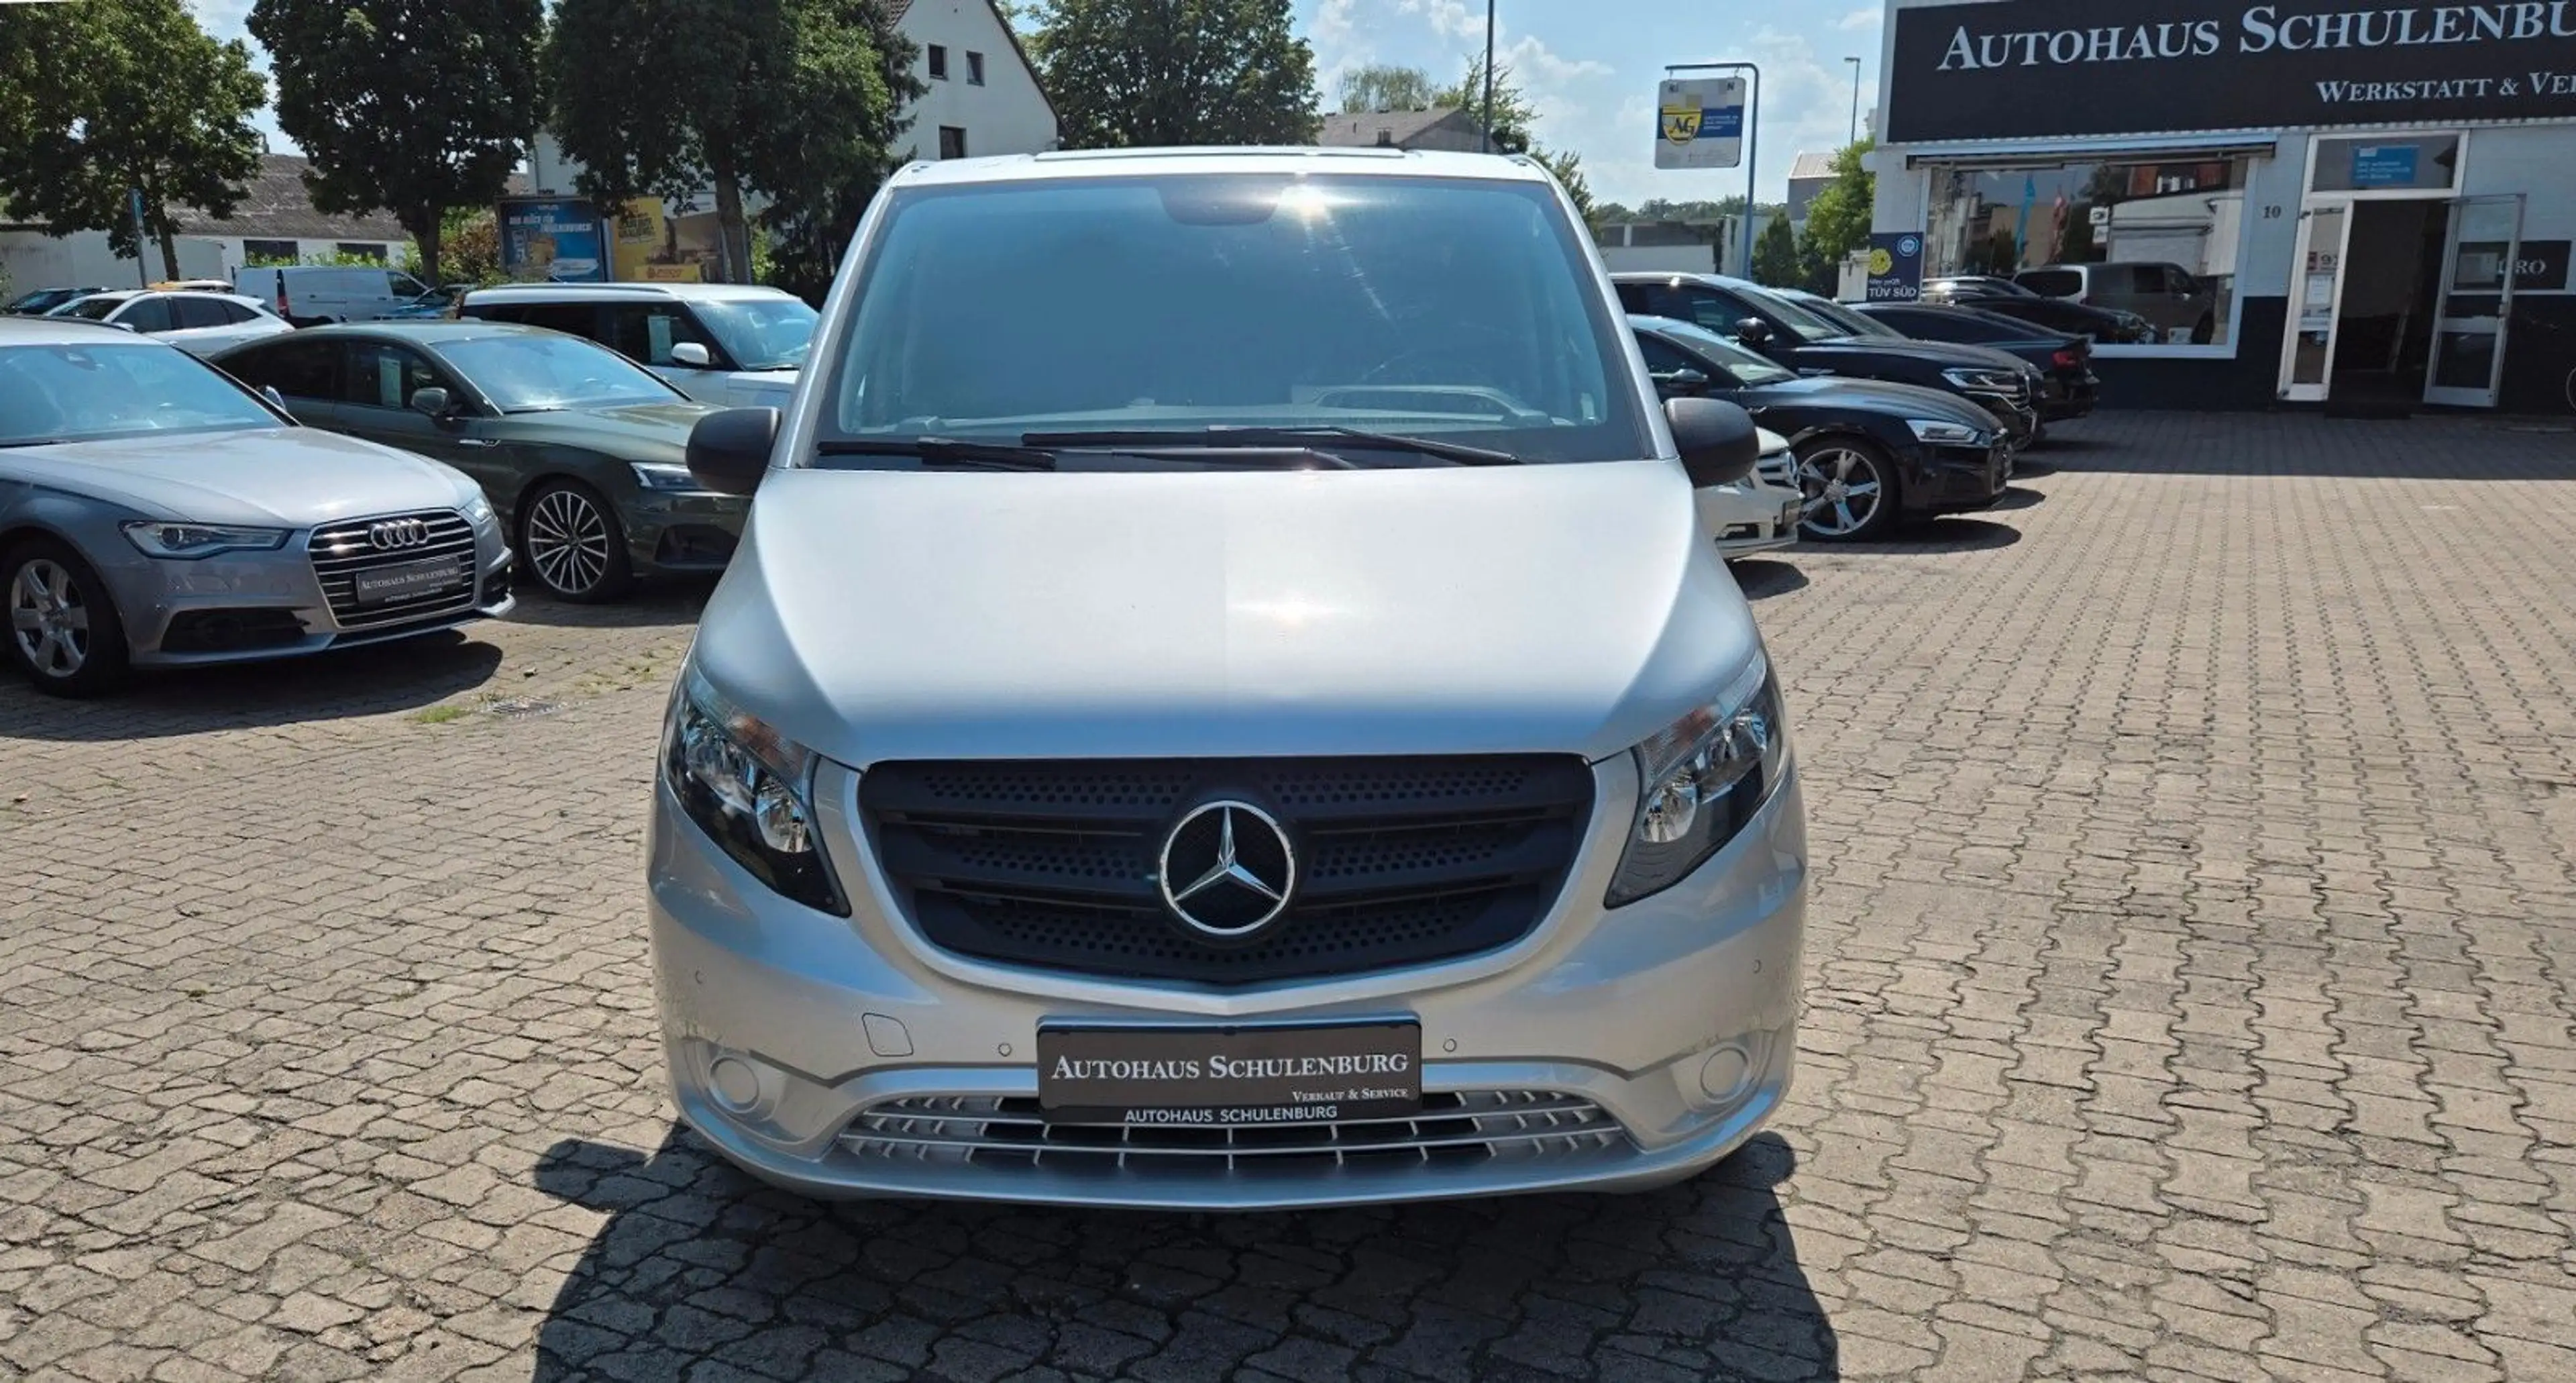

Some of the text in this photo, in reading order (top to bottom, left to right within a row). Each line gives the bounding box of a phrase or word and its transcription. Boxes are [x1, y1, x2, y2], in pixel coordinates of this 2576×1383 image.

[1935, 19, 2220, 70] AUTOHAUS
[2316, 78, 2493, 103] WERKSTATT
[2499, 77, 2520, 96] &
[2263, 205, 2282, 219] 10
[1869, 285, 1917, 297] TÜV SÜD
[1052, 1053, 1409, 1080] AUTOHAUS SCHULENBURG
[1348, 1088, 1358, 1100] &
[1361, 1088, 1409, 1099] SERVICE
[1124, 1105, 1338, 1123] AUTOHAUS SCHULENBURG
